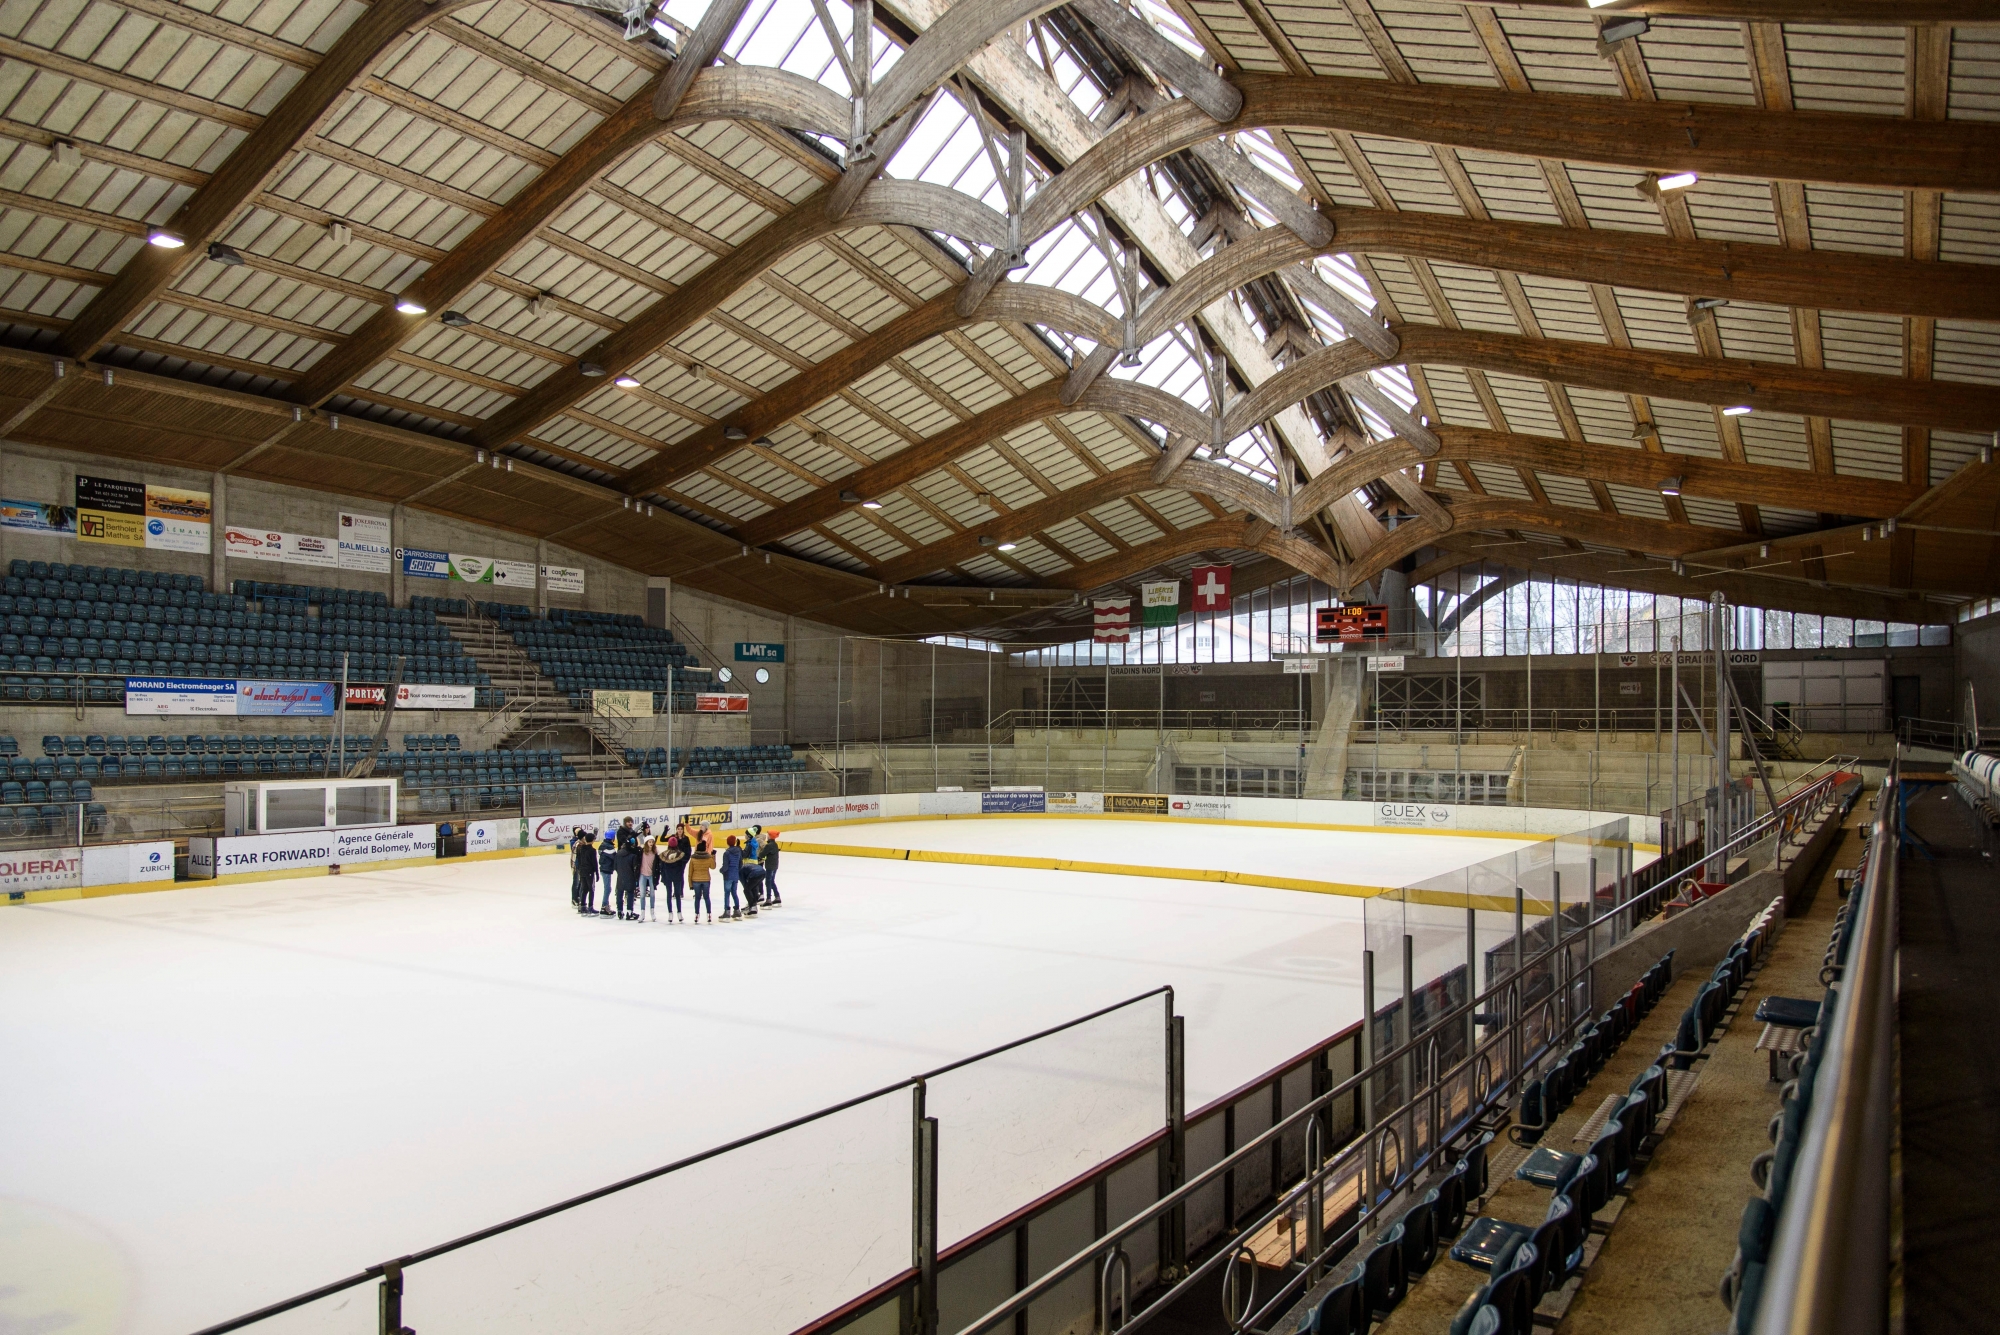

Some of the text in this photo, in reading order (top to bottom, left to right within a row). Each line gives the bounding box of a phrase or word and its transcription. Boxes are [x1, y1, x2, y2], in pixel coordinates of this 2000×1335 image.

[103, 483, 144, 494] PARQUETEUR
[106, 523, 137, 533] Bertholet
[106, 531, 131, 540] Mathis
[298, 541, 325, 550] Bouchers
[339, 541, 391, 555] BALMELLI SA
[395, 548, 403, 560] G
[403, 549, 447, 561] CARROSSERIE
[540, 566, 547, 576] H
[742, 644, 767, 657] LMT
[1110, 667, 1140, 675] GRADINS
[128, 681, 165, 689] MORAND
[166, 682, 224, 691] Electroménager
[1115, 798, 1140, 807] NEON
[740, 808, 791, 820] www.netimmo-sa.ch
[1381, 804, 1426, 818] GUEX
[659, 814, 670, 823] SA
[680, 812, 726, 825] NETIMMO
[548, 825, 571, 834] CAVE
[338, 830, 414, 845] Agence Générale
[338, 841, 436, 856] Gérald Bolomey, Morg
[225, 853, 258, 866] STAR
[262, 847, 330, 863] FORWARD!
[0, 858, 79, 877] QUERAT
[140, 864, 170, 873] ZURICH
[4, 873, 78, 884] UMATIQUES
